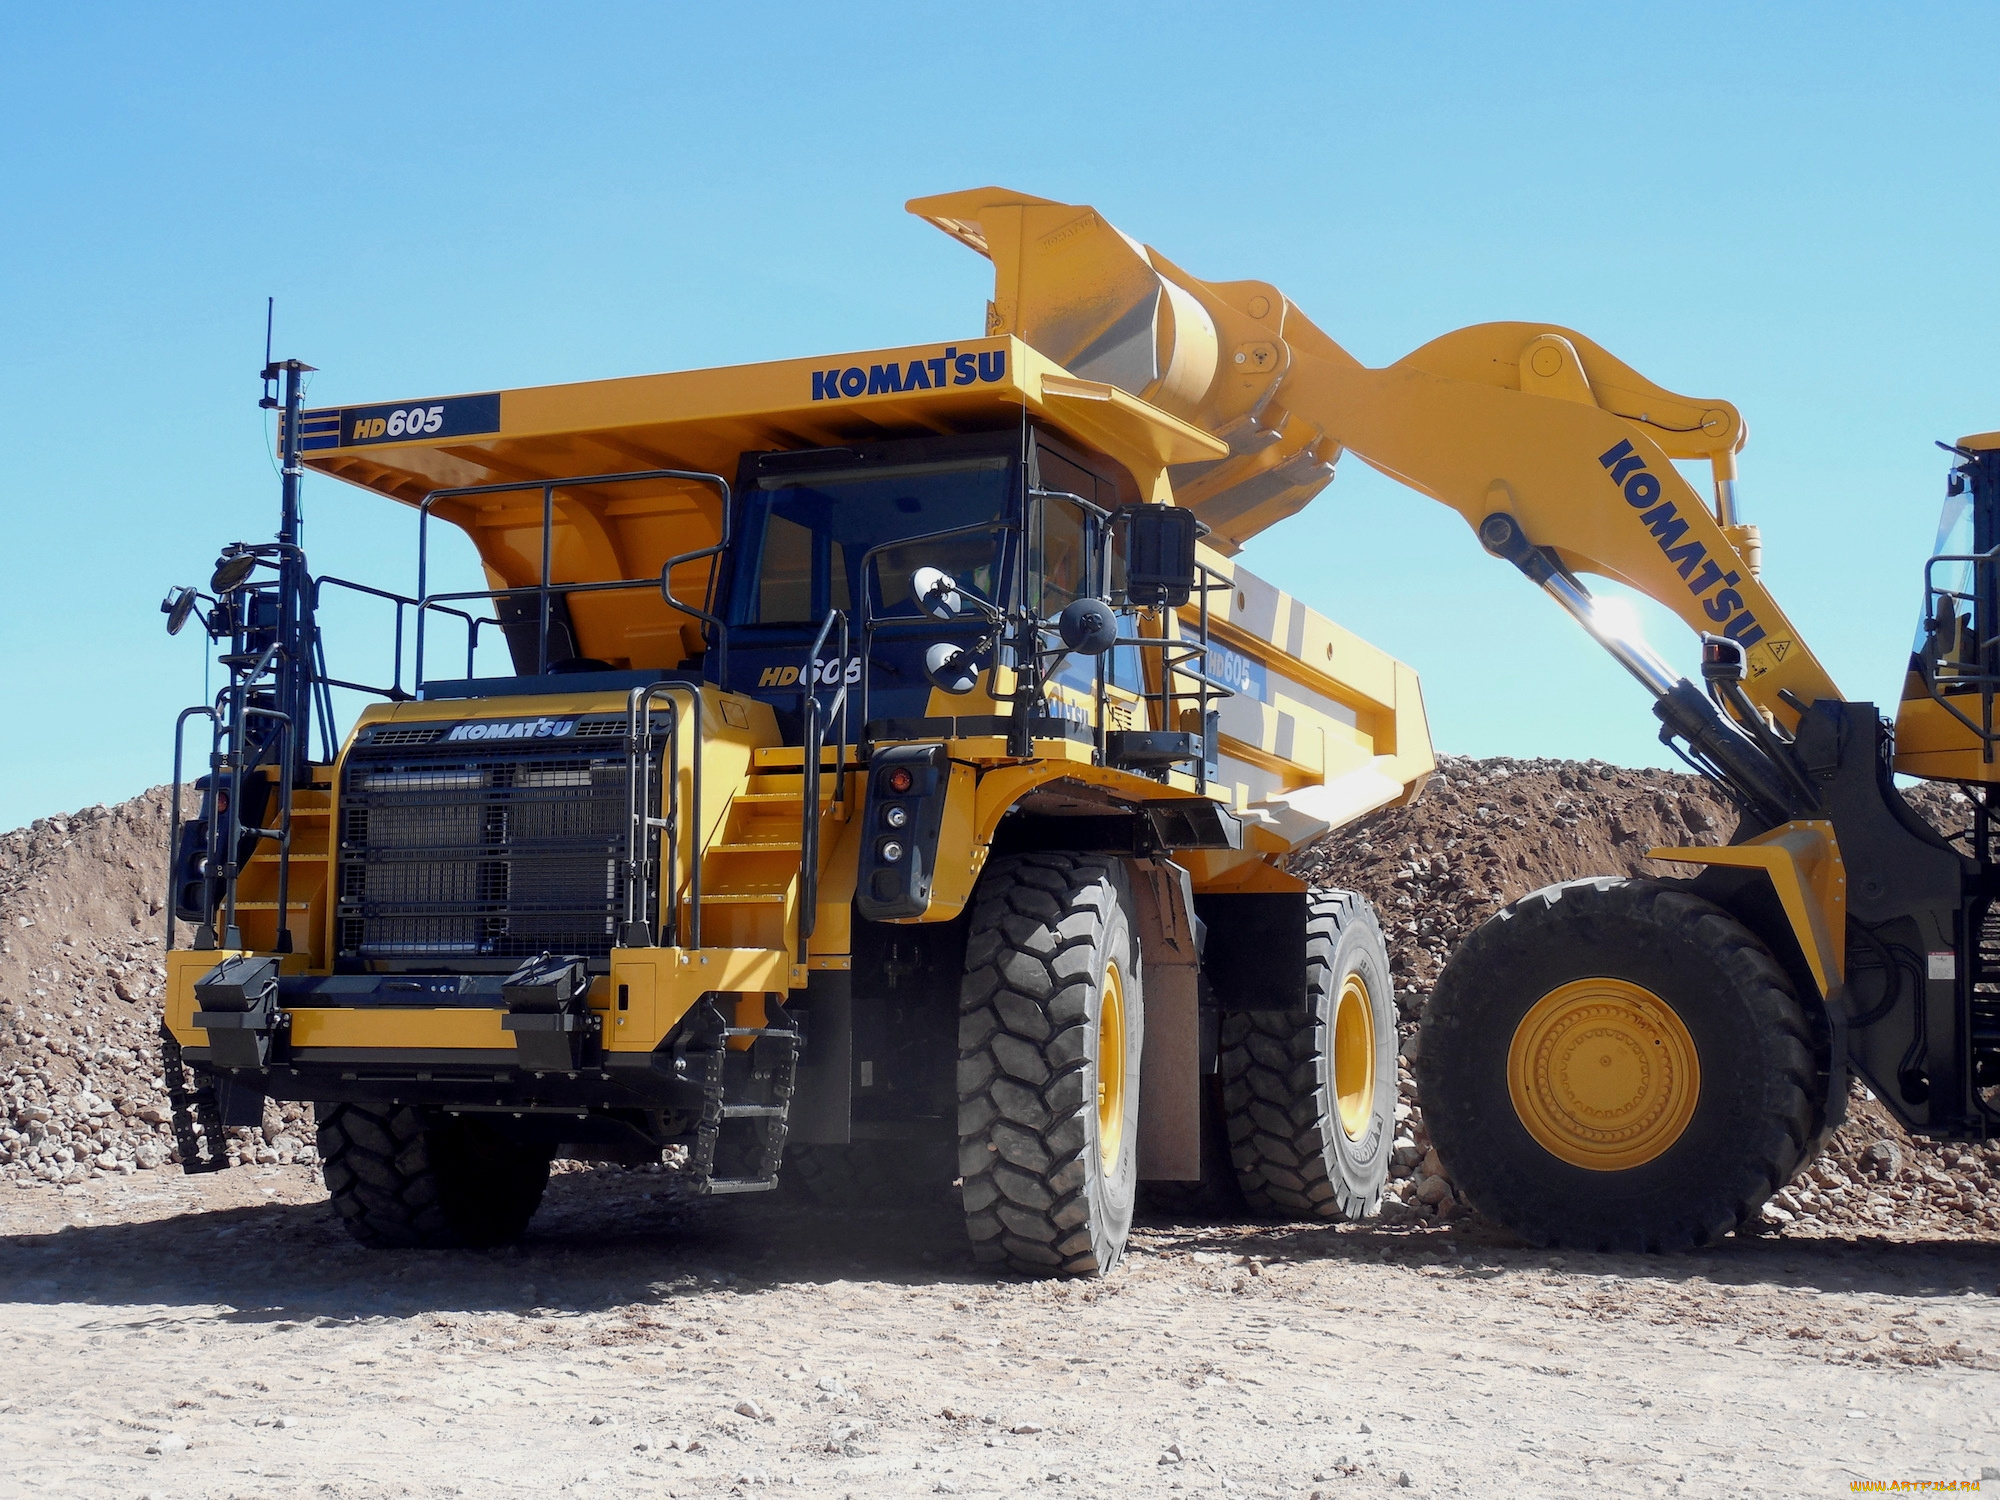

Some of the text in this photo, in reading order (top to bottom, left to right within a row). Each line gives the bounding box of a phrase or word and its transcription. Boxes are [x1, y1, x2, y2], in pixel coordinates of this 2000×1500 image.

[812, 347, 1005, 400] KOMATSU
[352, 405, 444, 439] HD605
[1598, 438, 1767, 649] KOMATSU
[758, 656, 861, 687] HD605
[1208, 650, 1250, 691] HD605
[449, 717, 574, 740] KOMATSU
